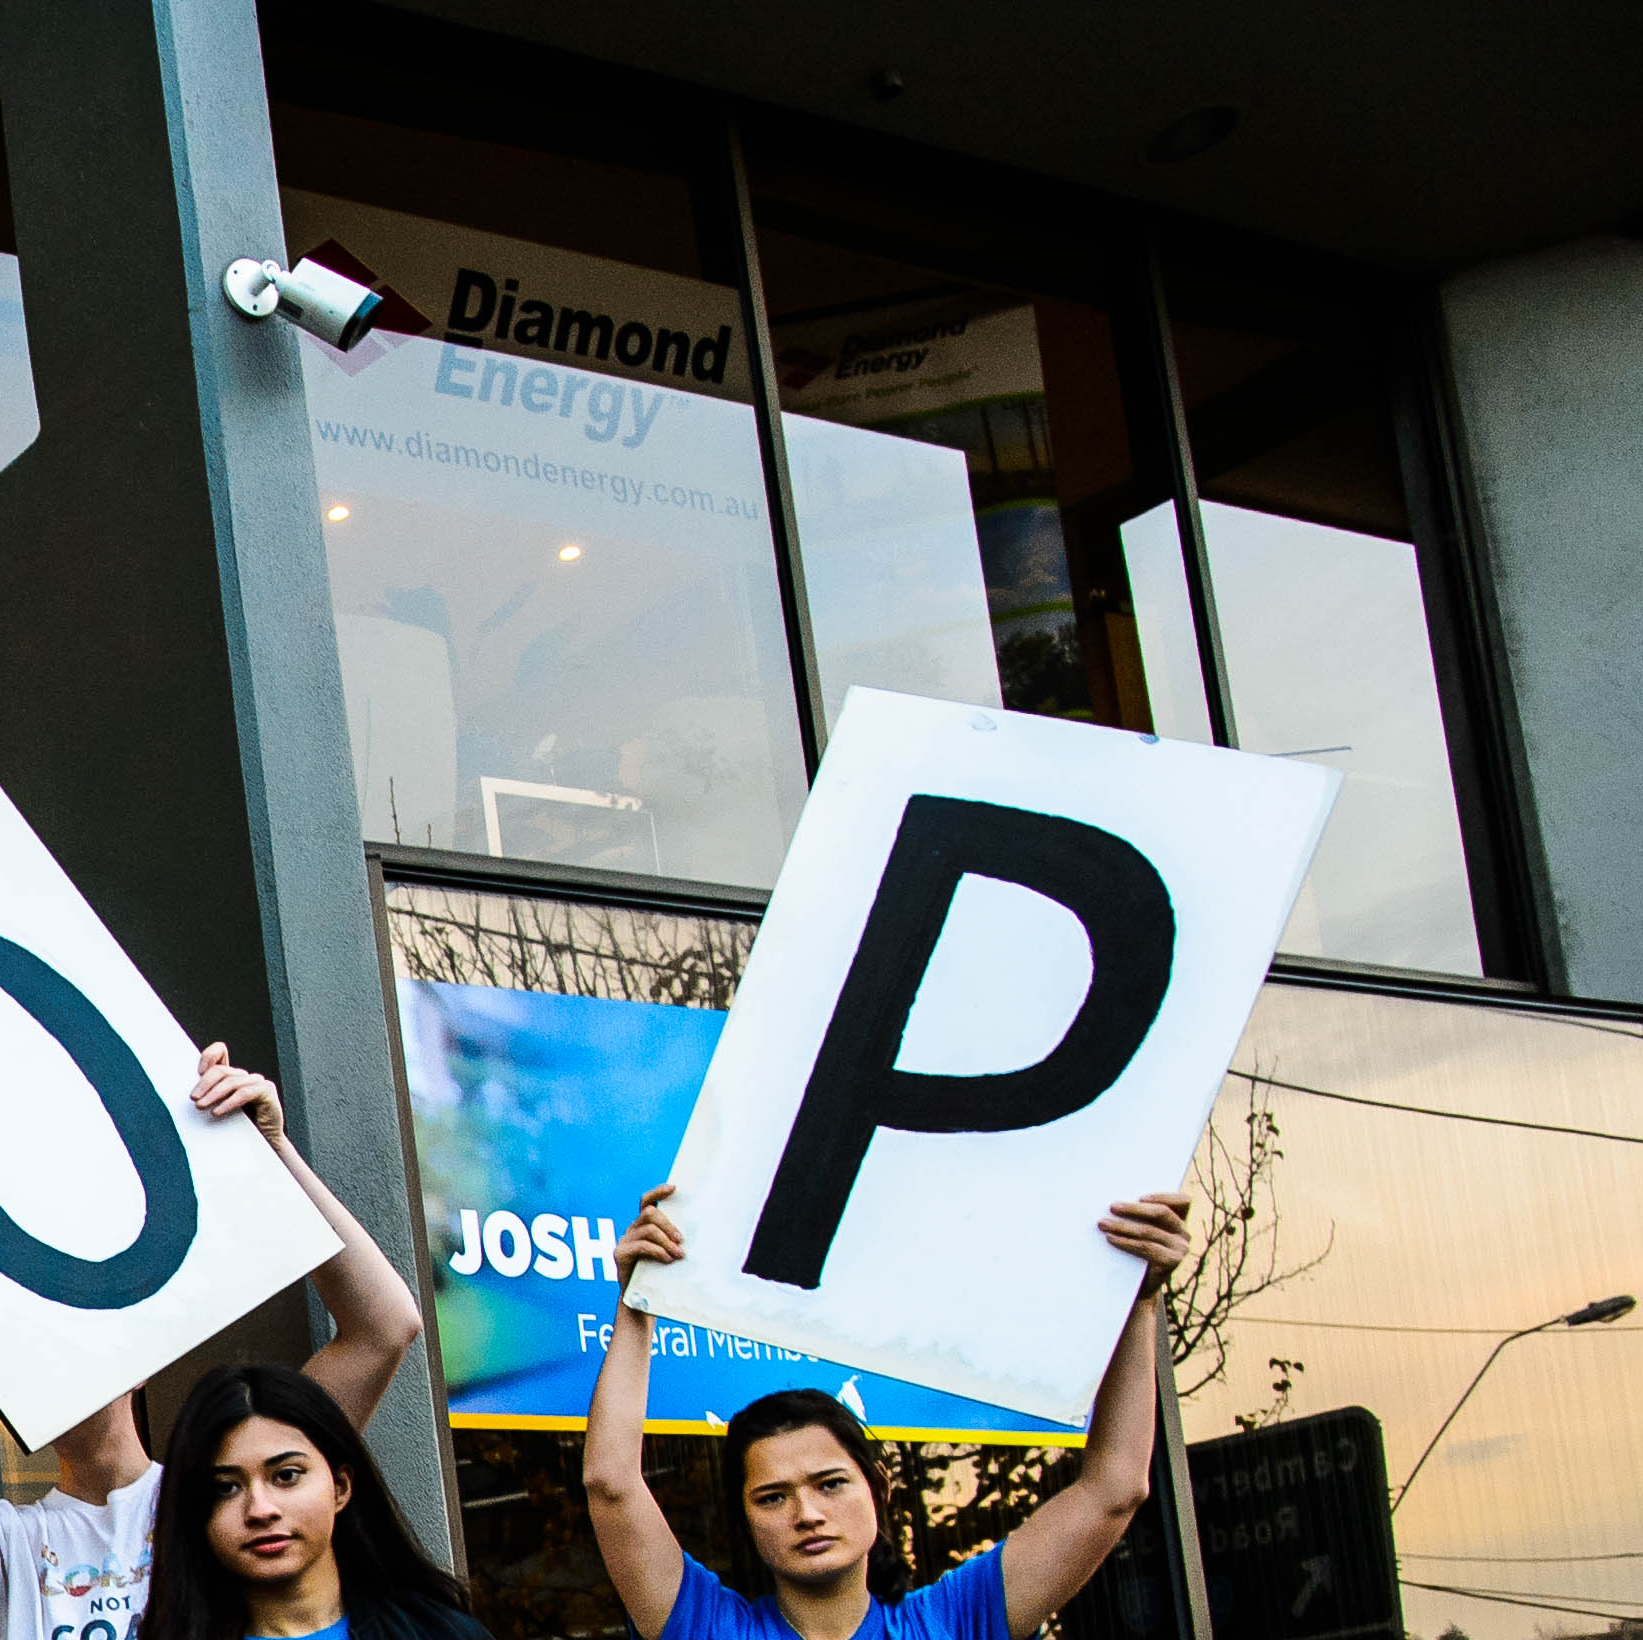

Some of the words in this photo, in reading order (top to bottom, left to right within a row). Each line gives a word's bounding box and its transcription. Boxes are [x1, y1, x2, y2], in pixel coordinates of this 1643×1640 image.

[446, 267, 734, 385] Diamond
[434, 332, 665, 450] Energy
[836, 349, 931, 380] Energy
[315, 416, 762, 522] www.diamondenergy.com.au
[449, 1209, 619, 1283] JOSH
[576, 1313, 697, 1357] Feeral
[90, 1595, 131, 1614] NOT
